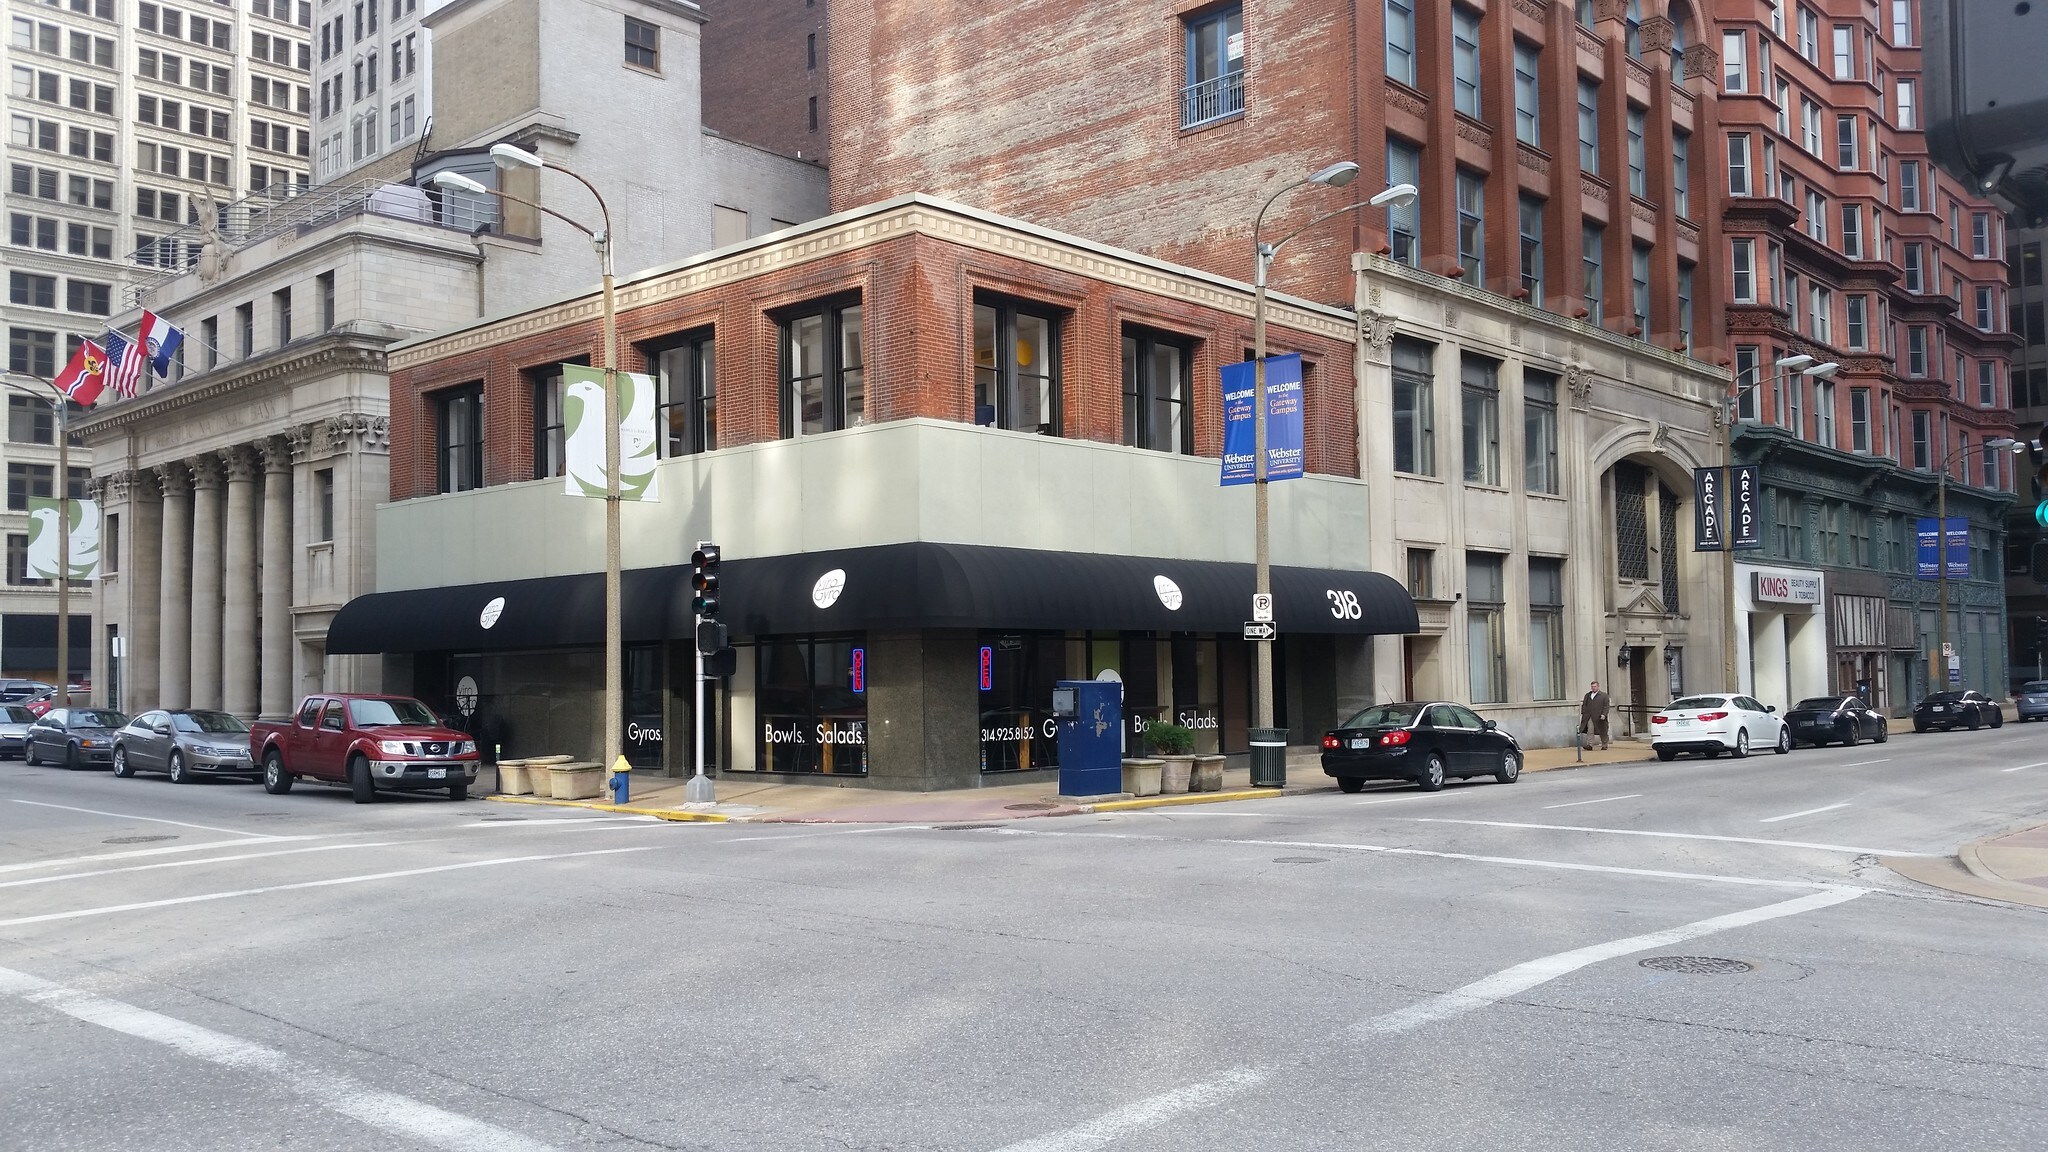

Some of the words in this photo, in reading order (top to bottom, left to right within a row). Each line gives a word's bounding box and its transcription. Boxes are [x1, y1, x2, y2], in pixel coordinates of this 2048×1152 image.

[1267, 381, 1300, 394] WELCOME
[1225, 389, 1255, 401] WELCOME
[1228, 405, 1252, 414] Gateway
[1270, 398, 1298, 408] Gateway
[1228, 413, 1251, 422] Campus
[1271, 406, 1298, 415] Campus
[1224, 453, 1255, 464] Webster
[1268, 448, 1302, 459] Webster
[1224, 462, 1255, 471] UNIVERSITY
[1269, 457, 1302, 466] UNIVERSITY
[1704, 472, 1714, 538] ARCADE
[1740, 469, 1751, 536] ARCADE
[1760, 576, 1788, 598] KINGS
[1791, 579, 1804, 588] BEAUTY
[1805, 580, 1817, 589] SUPPLY
[814, 589, 840, 605] Gyro
[1326, 589, 1362, 620] 318
[981, 649, 990, 688] OPEN
[1180, 709, 1219, 730] Salads.
[628, 722, 663, 746] Gyros.
[765, 723, 806, 744] Bowls.
[816, 723, 865, 745] Salads.
[981, 726, 1035, 742] 314.925.8152
